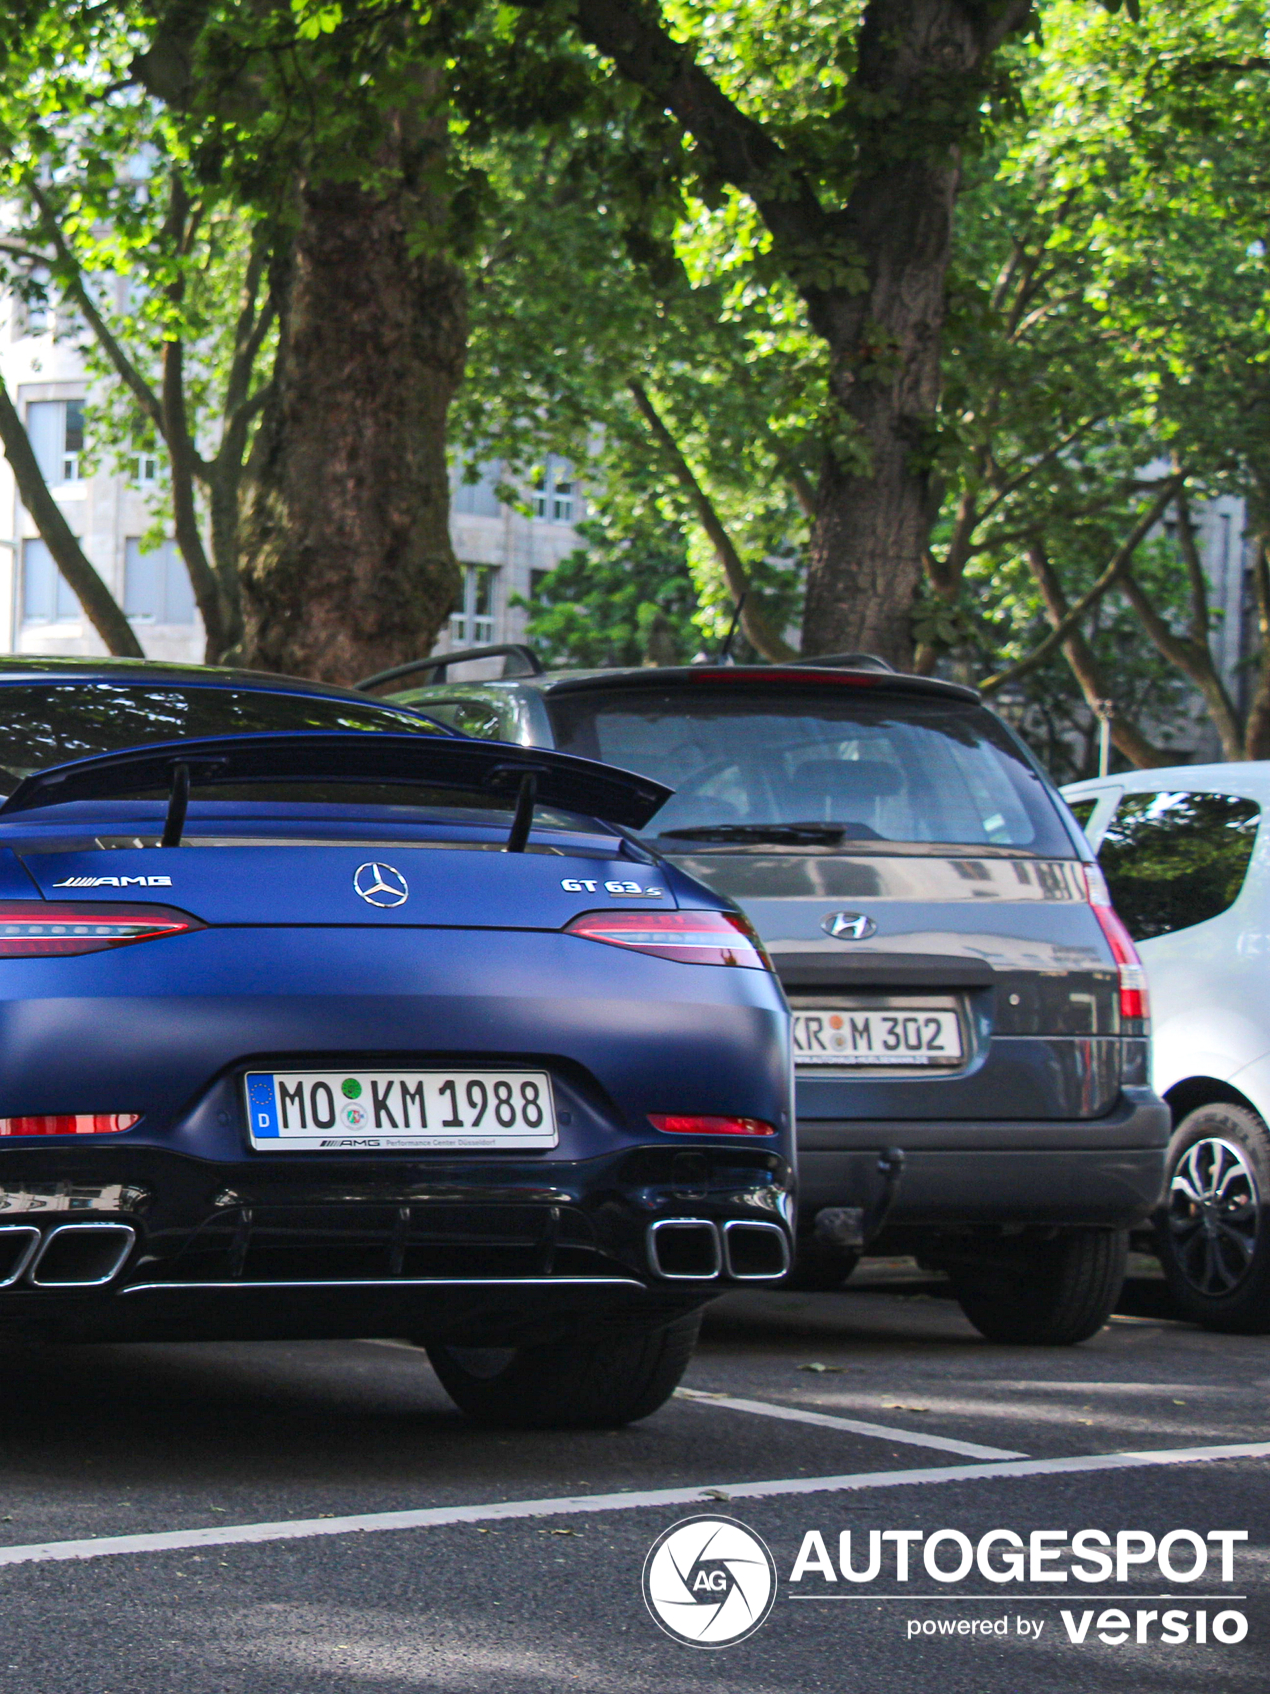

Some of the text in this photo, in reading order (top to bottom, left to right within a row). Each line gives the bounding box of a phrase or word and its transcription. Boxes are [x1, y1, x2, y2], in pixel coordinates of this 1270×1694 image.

[92, 876, 173, 887] AMG
[560, 879, 598, 893] GT
[604, 881, 642, 894] 63
[849, 1017, 872, 1050] M
[881, 1017, 945, 1051] 302
[279, 1079, 544, 1129] MO KM 1988
[258, 1113, 270, 1127] D
[339, 1138, 496, 1147] AMG Performance Center Düsseldorf
